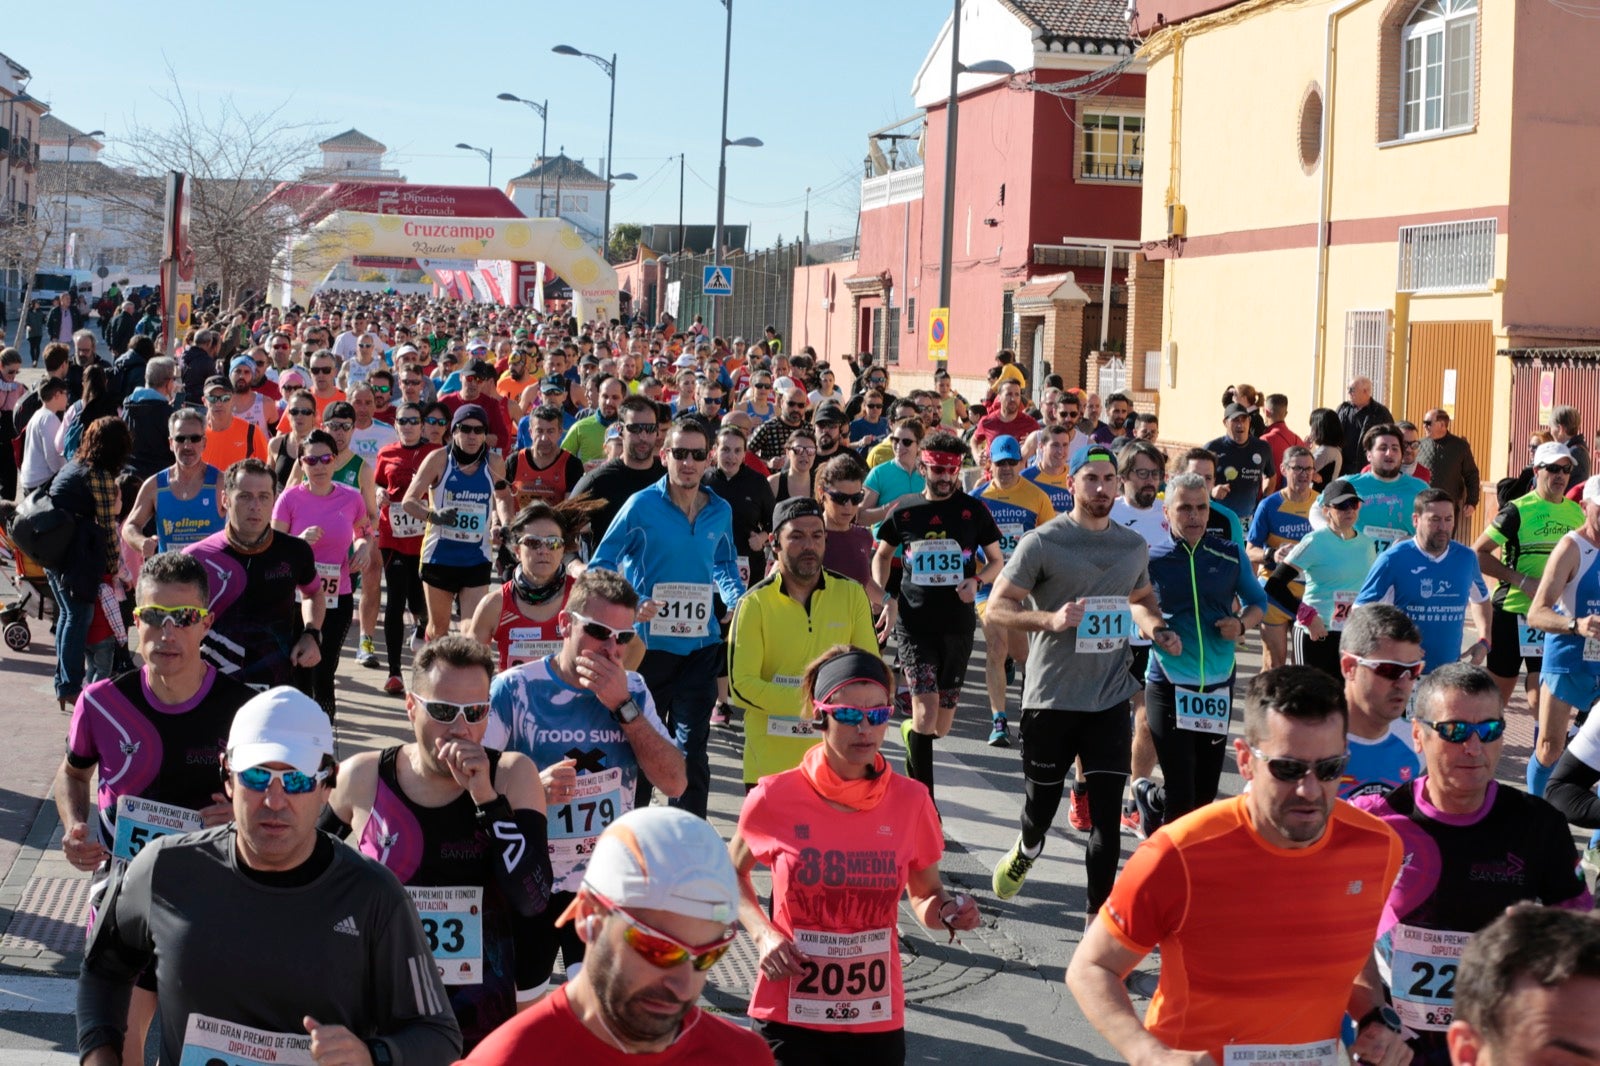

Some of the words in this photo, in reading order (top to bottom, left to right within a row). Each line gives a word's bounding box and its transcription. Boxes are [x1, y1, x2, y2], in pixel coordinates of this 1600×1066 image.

[402, 191, 456, 204] Diputación
[401, 205, 413, 214] de
[414, 206, 456, 217] Granada
[403, 221, 495, 241] Cruzcampo
[411, 241, 456, 255] Radler
[455, 489, 490, 501] olimpo
[990, 507, 1027, 518] ustinos
[175, 517, 211, 529] olimpo
[915, 553, 961, 572] 1135
[658, 600, 706, 620] 3116
[1087, 614, 1123, 636] 311
[1178, 695, 1228, 718] 1069
[539, 729, 586, 743] TODO
[557, 797, 615, 834] 179
[797, 846, 846, 887] 38
[846, 858, 897, 875] MEDIA
[418, 889, 443, 900] PREMIO
[444, 889, 453, 900] DE
[454, 889, 477, 900] FONDO
[819, 934, 837, 944] GRAN
[838, 936, 859, 946] PREMIO
[859, 934, 866, 943] DE
[867, 931, 886, 942] FONDO
[1423, 932, 1442, 944] GRAN
[795, 958, 886, 996] 2050
[1408, 961, 1458, 999] 22
[195, 1018, 219, 1034] XXXIII
[219, 1024, 242, 1039] GRAN
[242, 1030, 273, 1047] PREMIO
[274, 1036, 285, 1048] DE
[228, 1040, 277, 1061] DIPUTACIÓN
